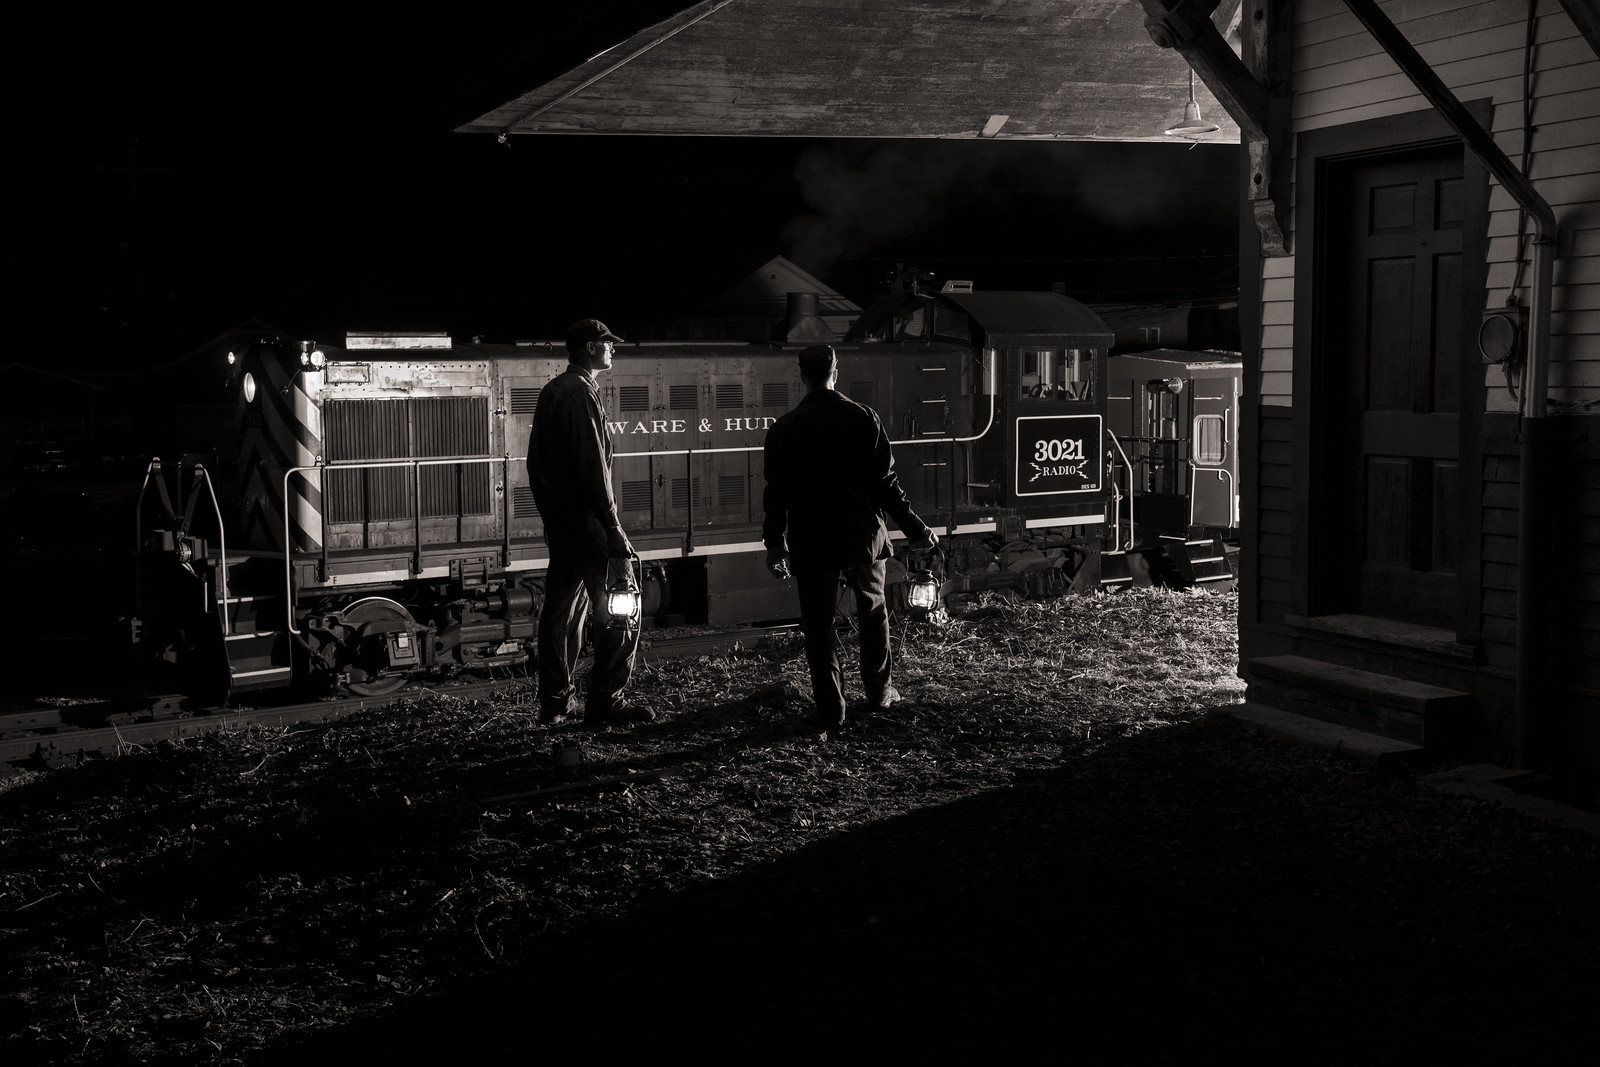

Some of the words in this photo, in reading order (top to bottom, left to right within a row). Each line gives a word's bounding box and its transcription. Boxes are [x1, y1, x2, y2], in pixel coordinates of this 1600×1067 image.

[698, 418, 713, 432] &
[1034, 438, 1085, 461] 3021
[1042, 465, 1076, 477] RADIO
